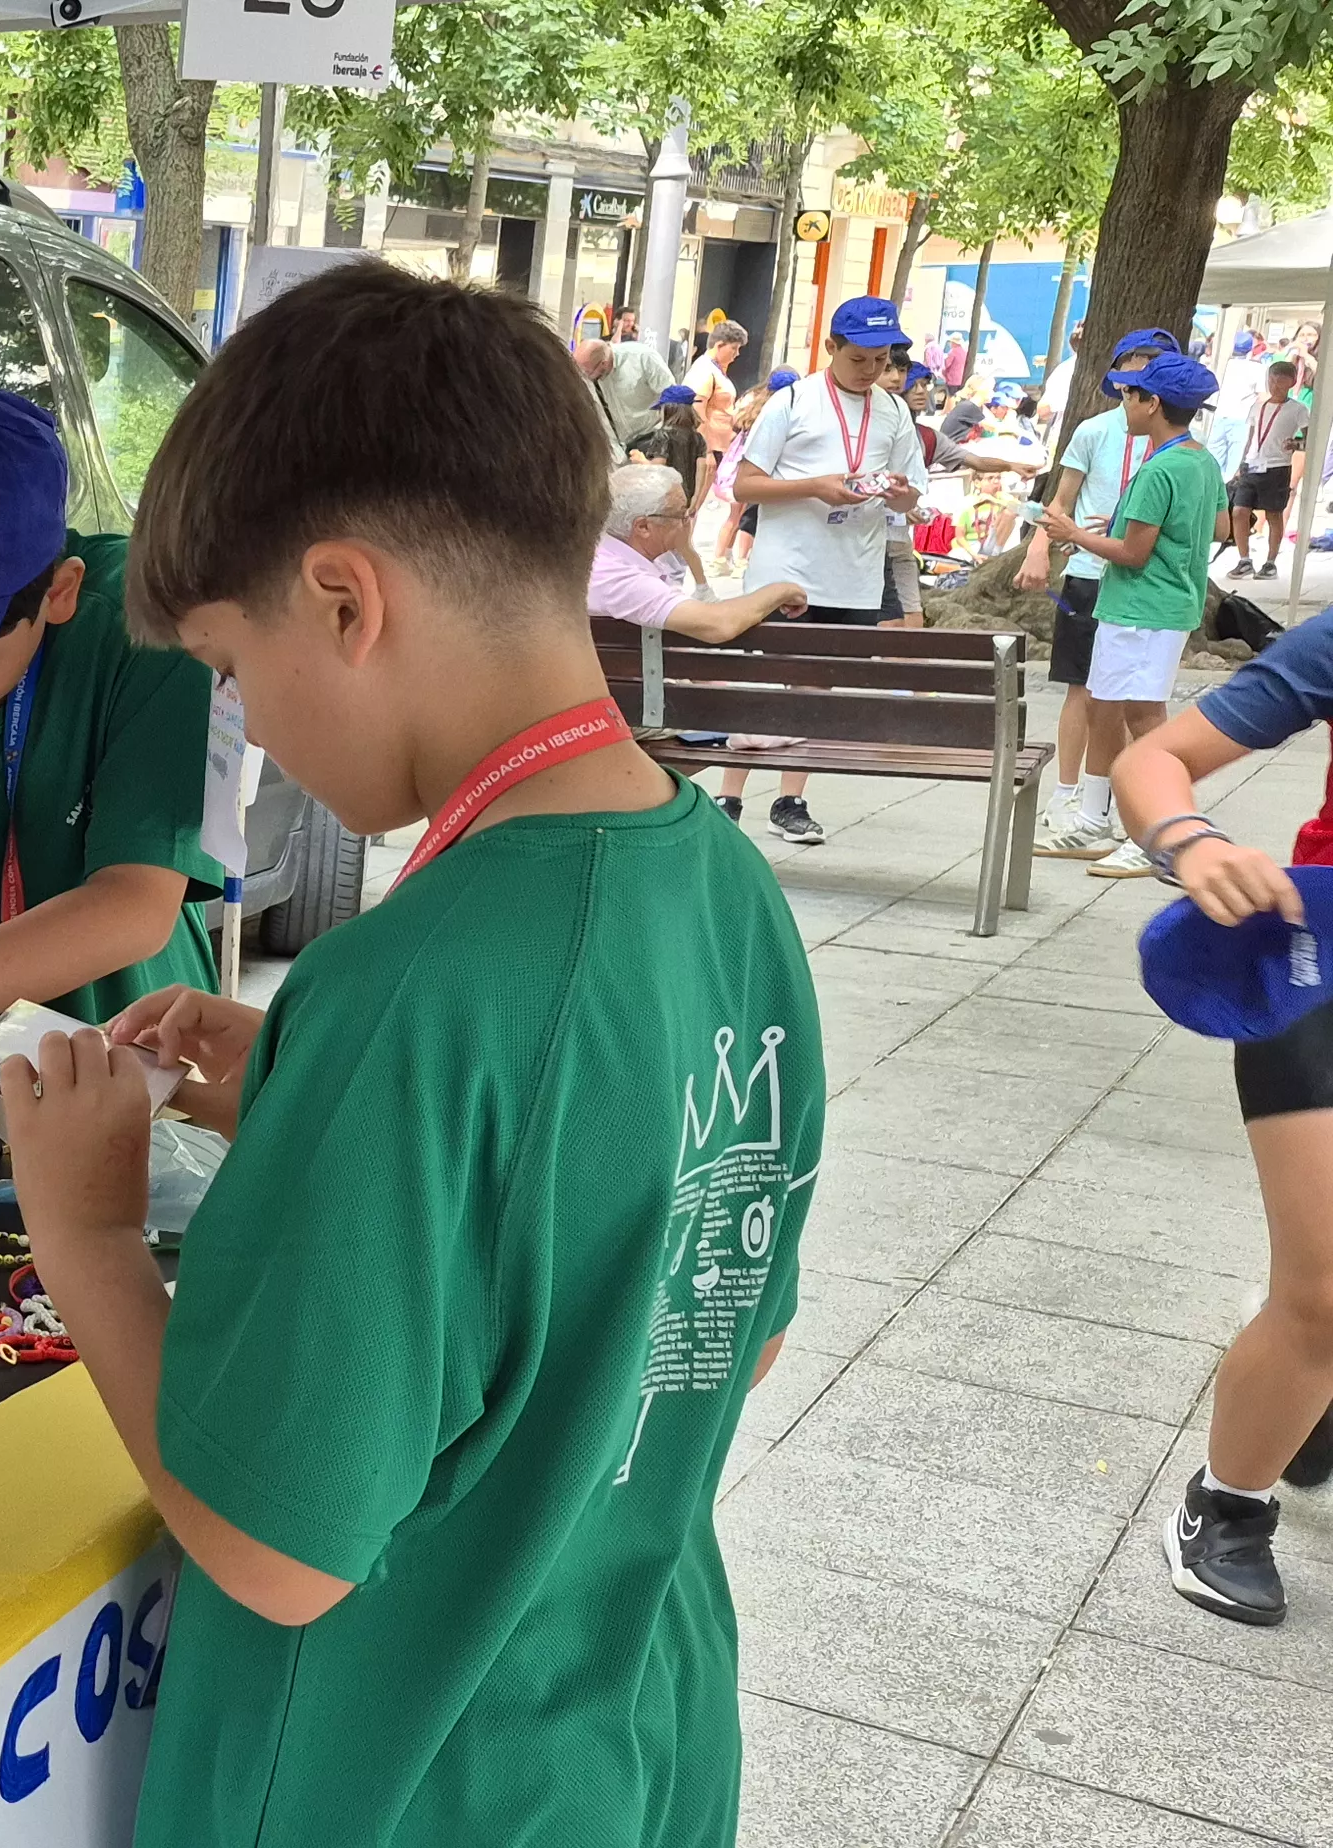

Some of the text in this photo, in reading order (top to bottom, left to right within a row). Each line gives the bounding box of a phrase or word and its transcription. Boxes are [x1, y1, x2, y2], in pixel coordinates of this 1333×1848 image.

[333, 64, 368, 77] Ibercaja
[334, 52, 369, 63] Fundación
[8, 702, 23, 748] IBERCAJA
[441, 803, 467, 834] CON
[465, 741, 549, 807] FUNDACIÓN
[548, 717, 610, 750] IBERCAJA
